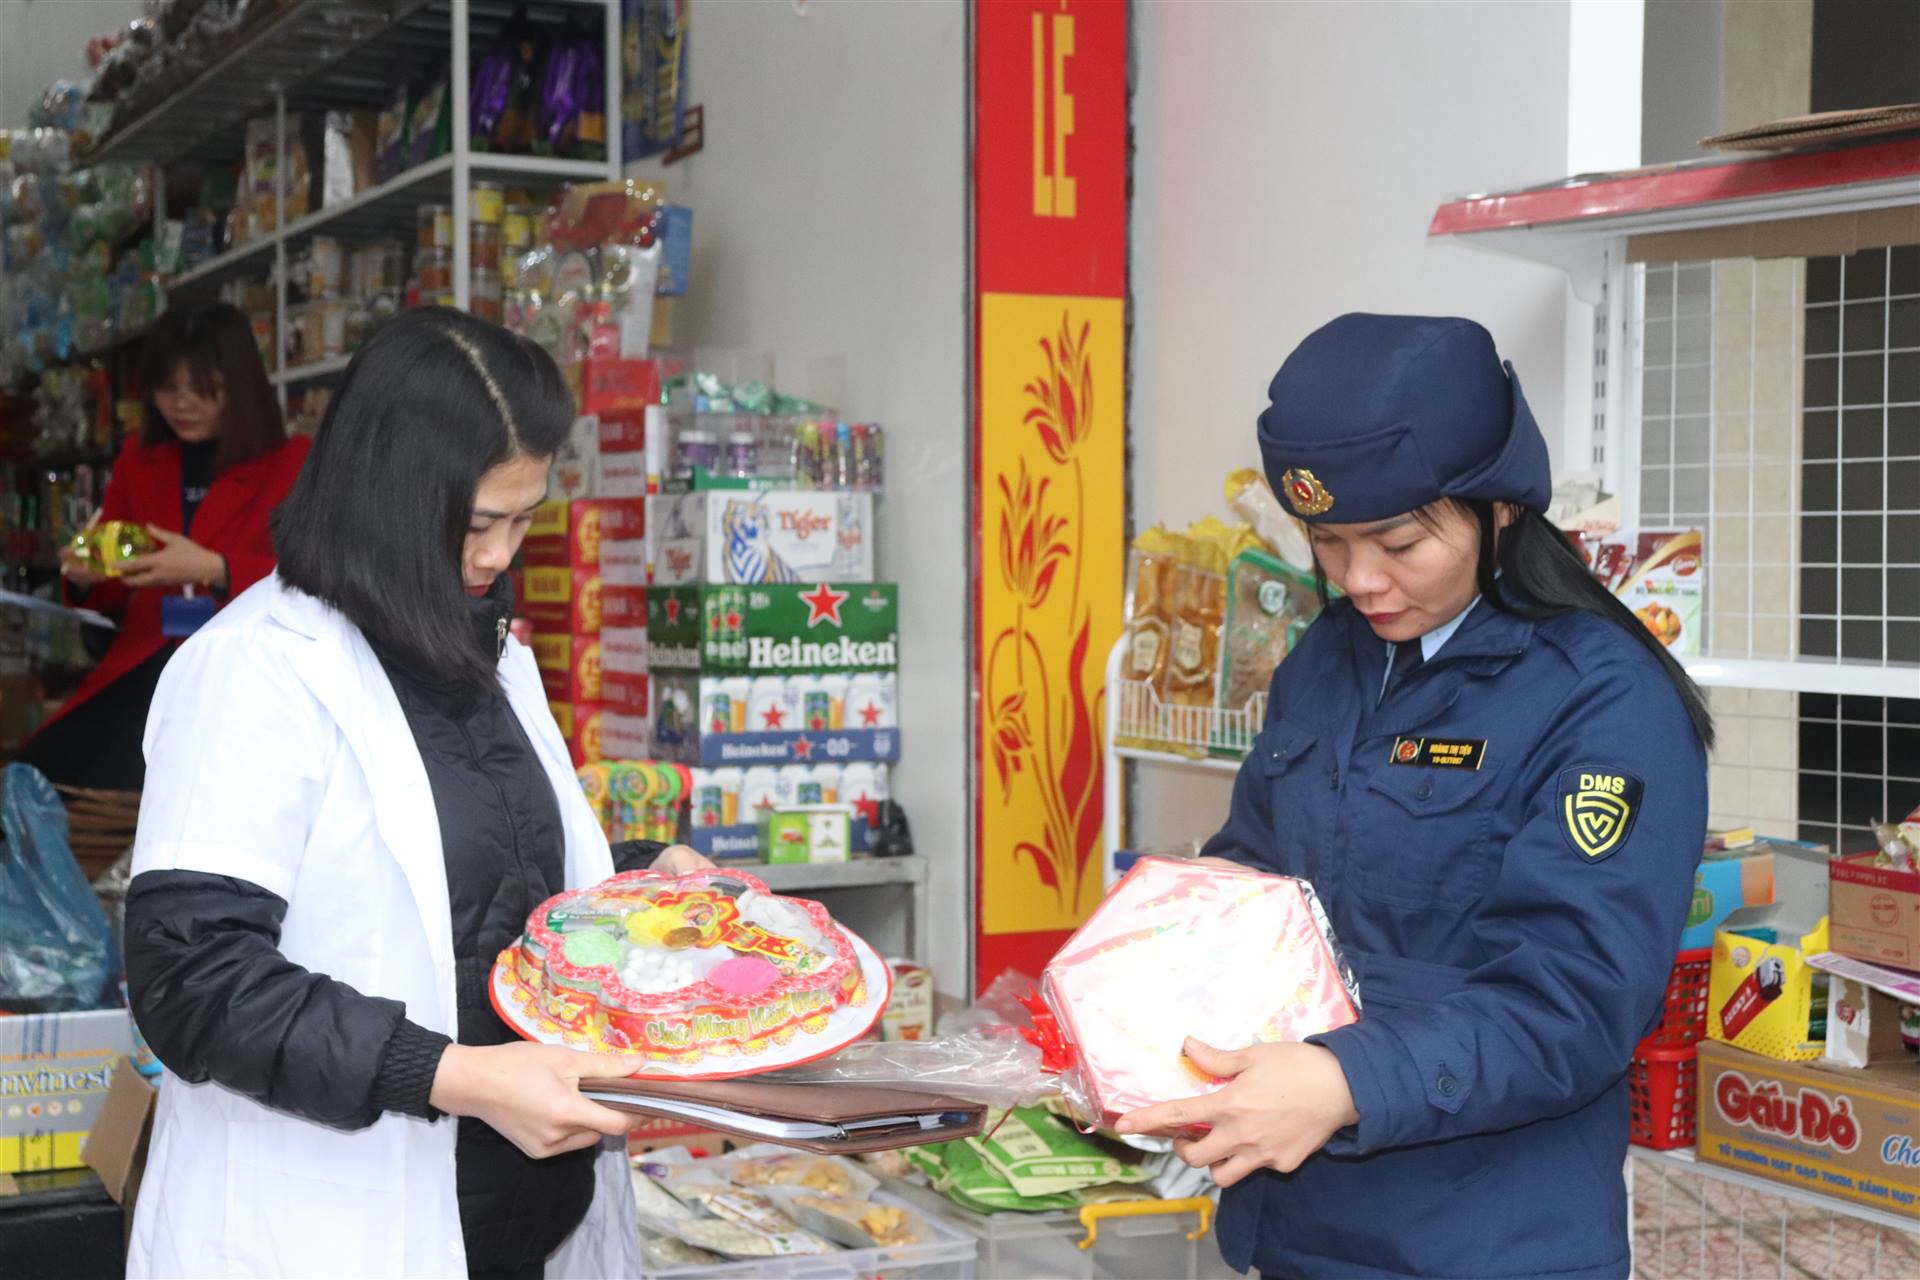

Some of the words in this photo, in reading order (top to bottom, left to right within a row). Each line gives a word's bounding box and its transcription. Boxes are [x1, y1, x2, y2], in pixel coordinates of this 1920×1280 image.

[777, 508, 832, 541] Tiger
[748, 634, 896, 669] Heineken
[721, 742, 788, 760] Heineken
[1579, 773, 1626, 795] DMS
[1716, 1074, 1797, 1137] Gấu
[1799, 1089, 1859, 1152] Đỏ
